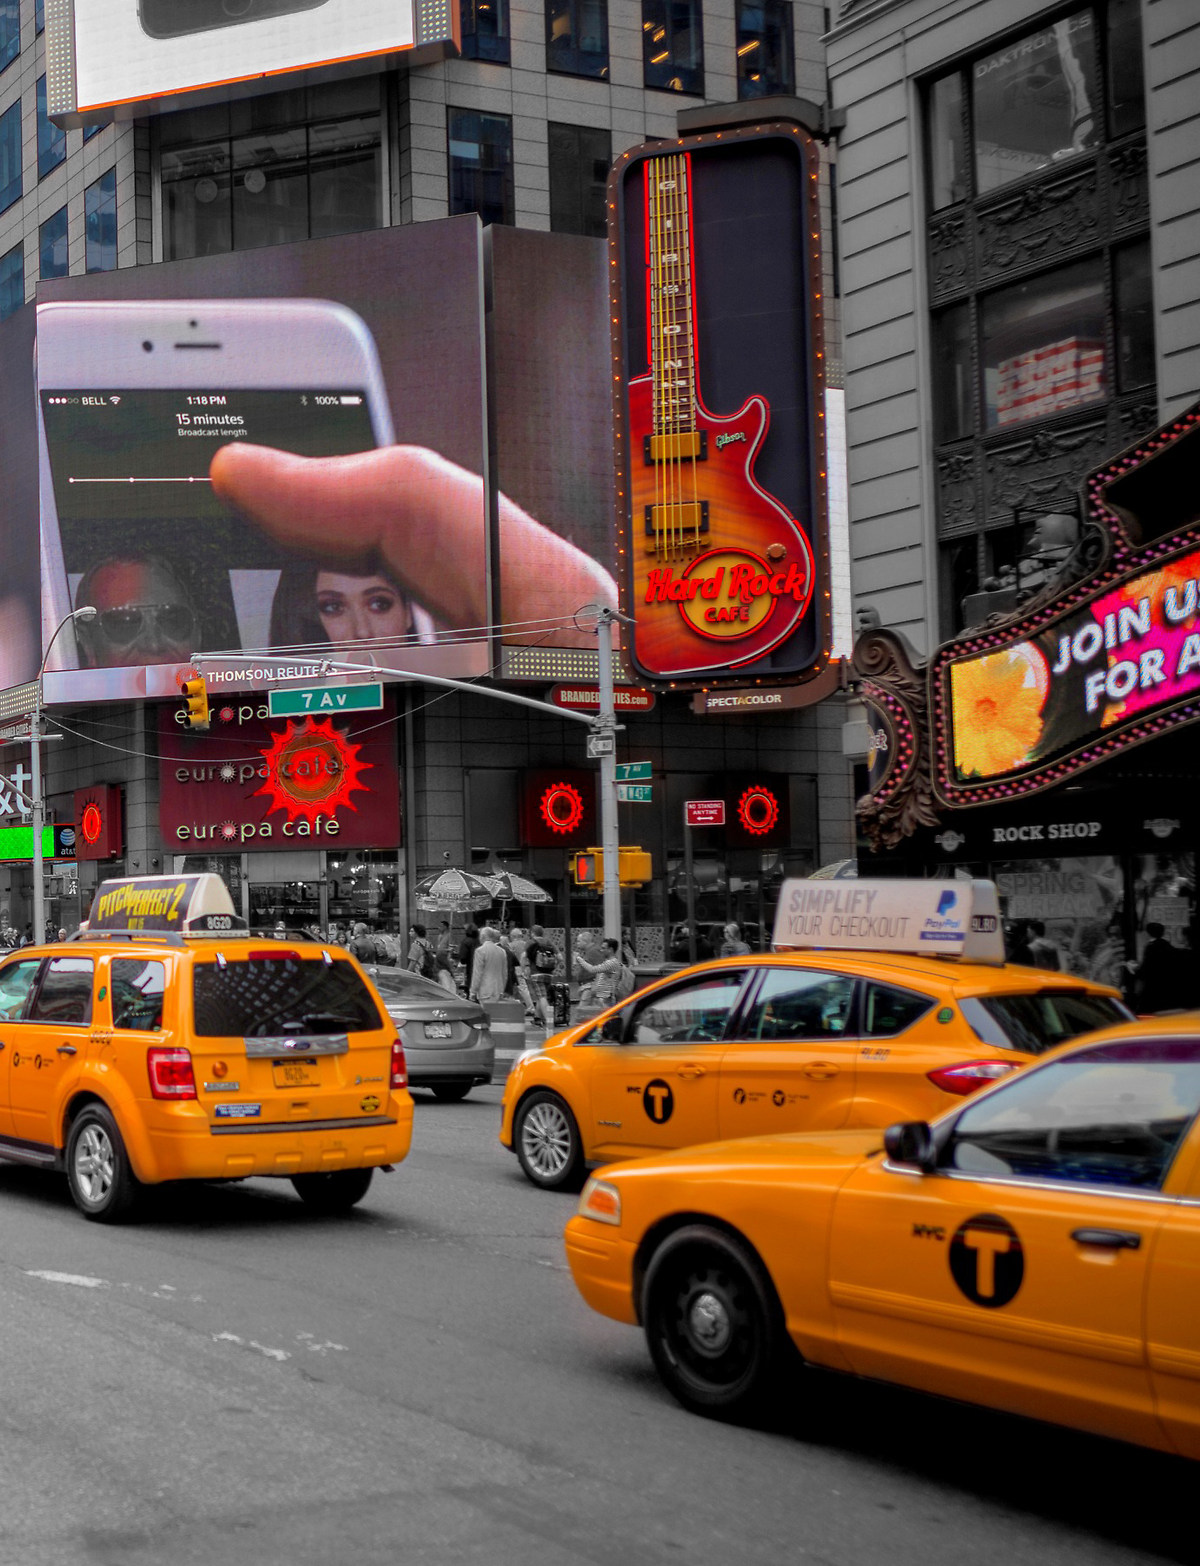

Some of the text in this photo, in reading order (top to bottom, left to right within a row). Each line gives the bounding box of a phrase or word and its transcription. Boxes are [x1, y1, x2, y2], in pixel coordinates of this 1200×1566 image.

[81, 396, 107, 406] BELL
[186, 396, 227, 405] 1:18 PM
[314, 396, 339, 405] 100%
[176, 413, 244, 425] 15 minutes
[178, 427, 247, 438] Broadcast length
[715, 431, 747, 450] Gibson
[644, 563, 807, 603] Hard Rock
[703, 607, 750, 622] CAFE
[1052, 579, 1200, 673] JOIN U
[207, 669, 274, 683] THOMSON
[1085, 648, 1167, 713] FOR
[301, 692, 347, 708] 7 Av
[706, 694, 782, 708] SPECTACOLOR
[174, 703, 268, 725] eropa
[282, 755, 339, 777] café
[623, 766, 631, 778] 7
[176, 815, 340, 843] europa café
[992, 822, 1101, 843] ROCK SHOP
[166, 882, 187, 921] 2
[789, 889, 879, 913] SIMPLIFY
[206, 916, 232, 930] 8G20
[787, 915, 822, 936] YOUR
[829, 915, 911, 938] CHECKOUT
[924, 918, 961, 930] PayPal
[912, 1223, 1011, 1298] NYC T
